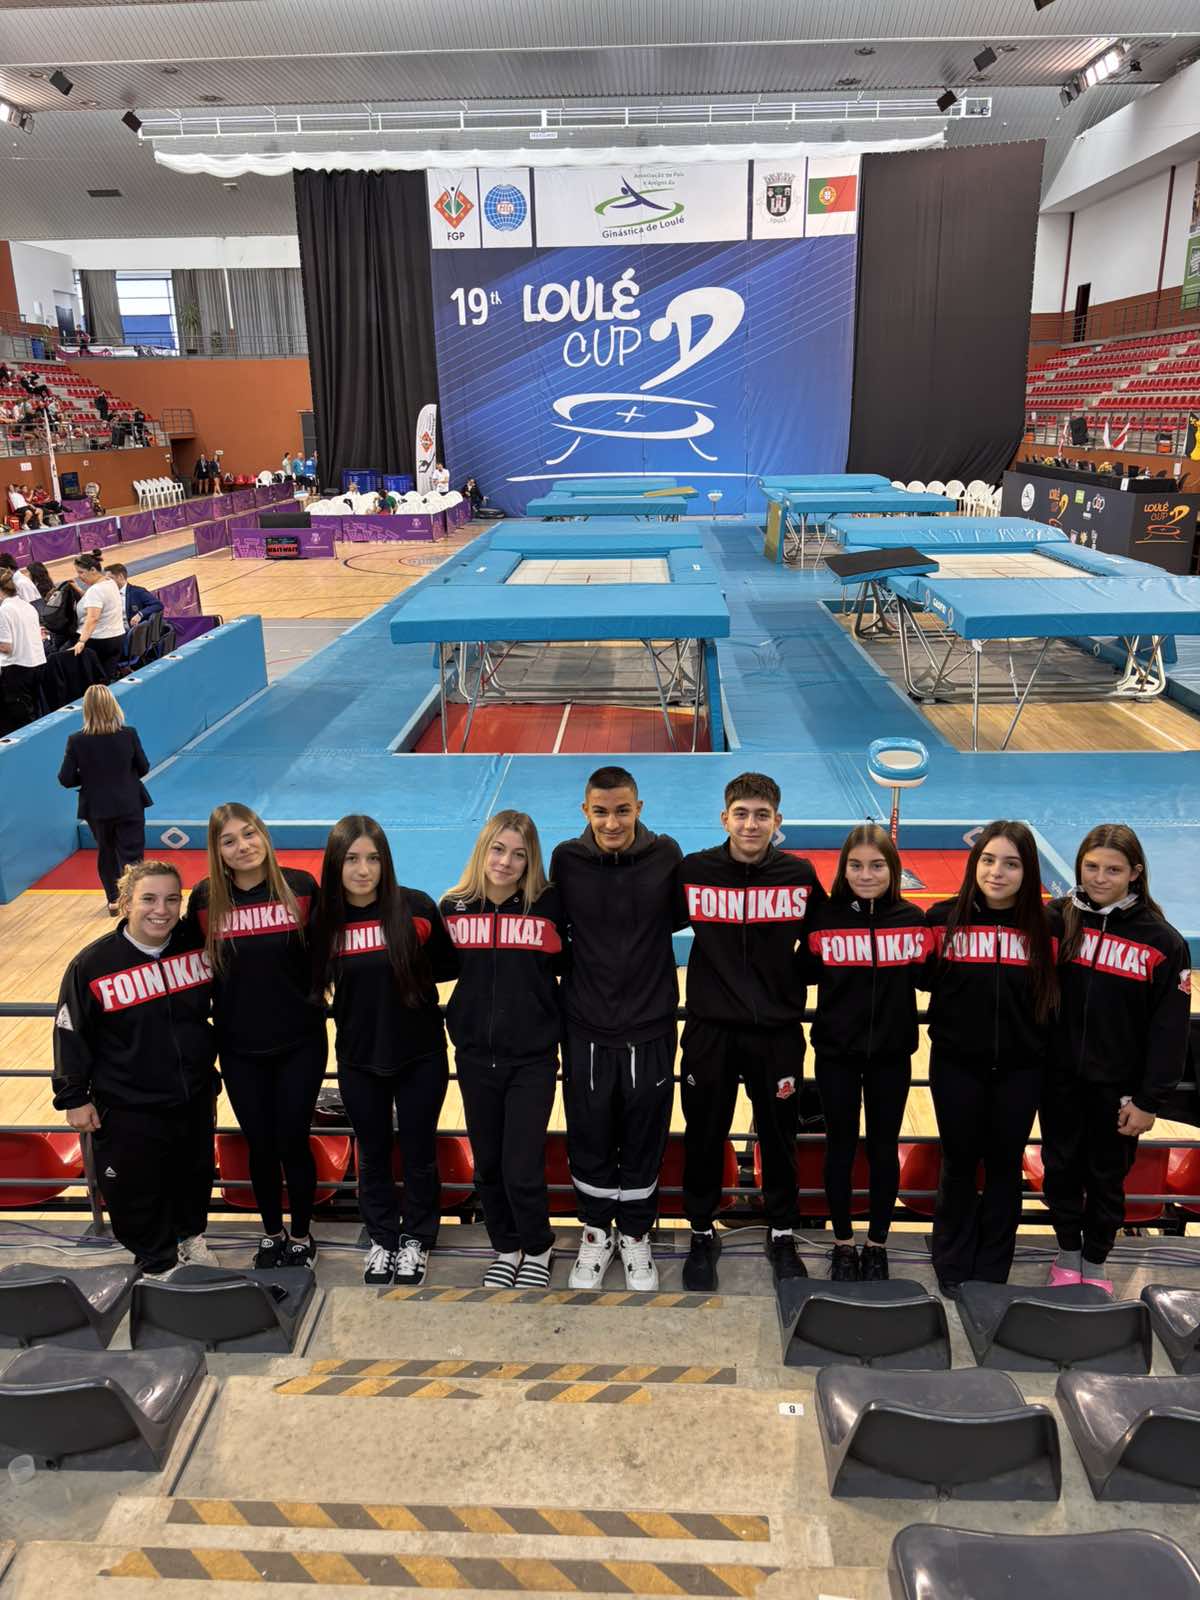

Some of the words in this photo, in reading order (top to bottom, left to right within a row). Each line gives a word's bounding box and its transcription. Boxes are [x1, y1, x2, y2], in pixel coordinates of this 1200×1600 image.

[447, 231, 465, 241] FGP
[602, 226, 644, 239] Ginástica
[646, 223, 658, 232] de
[660, 215, 685, 229] Loulé
[450, 287, 502, 326] 19th
[522, 267, 641, 323] LOULÉ
[562, 325, 642, 368] CUP
[688, 886, 808, 921] FOINIKAS
